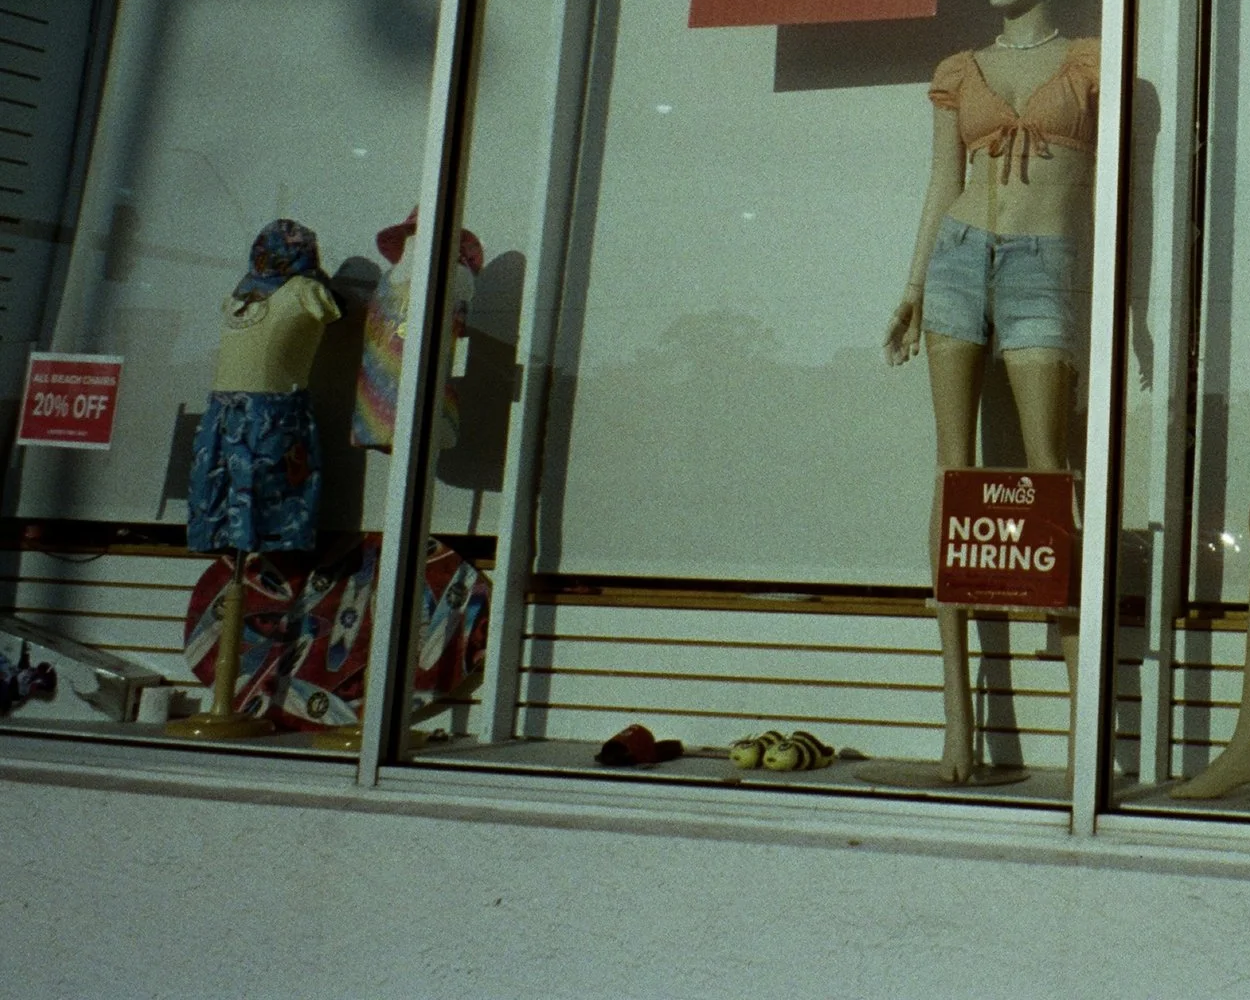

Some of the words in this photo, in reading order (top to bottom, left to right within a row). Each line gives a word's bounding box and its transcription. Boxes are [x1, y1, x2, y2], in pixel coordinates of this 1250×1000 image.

[31, 391, 70, 417] 20%
[73, 394, 110, 420] OFF
[948, 516, 1026, 543] NOW
[945, 543, 1057, 572] HIRING
